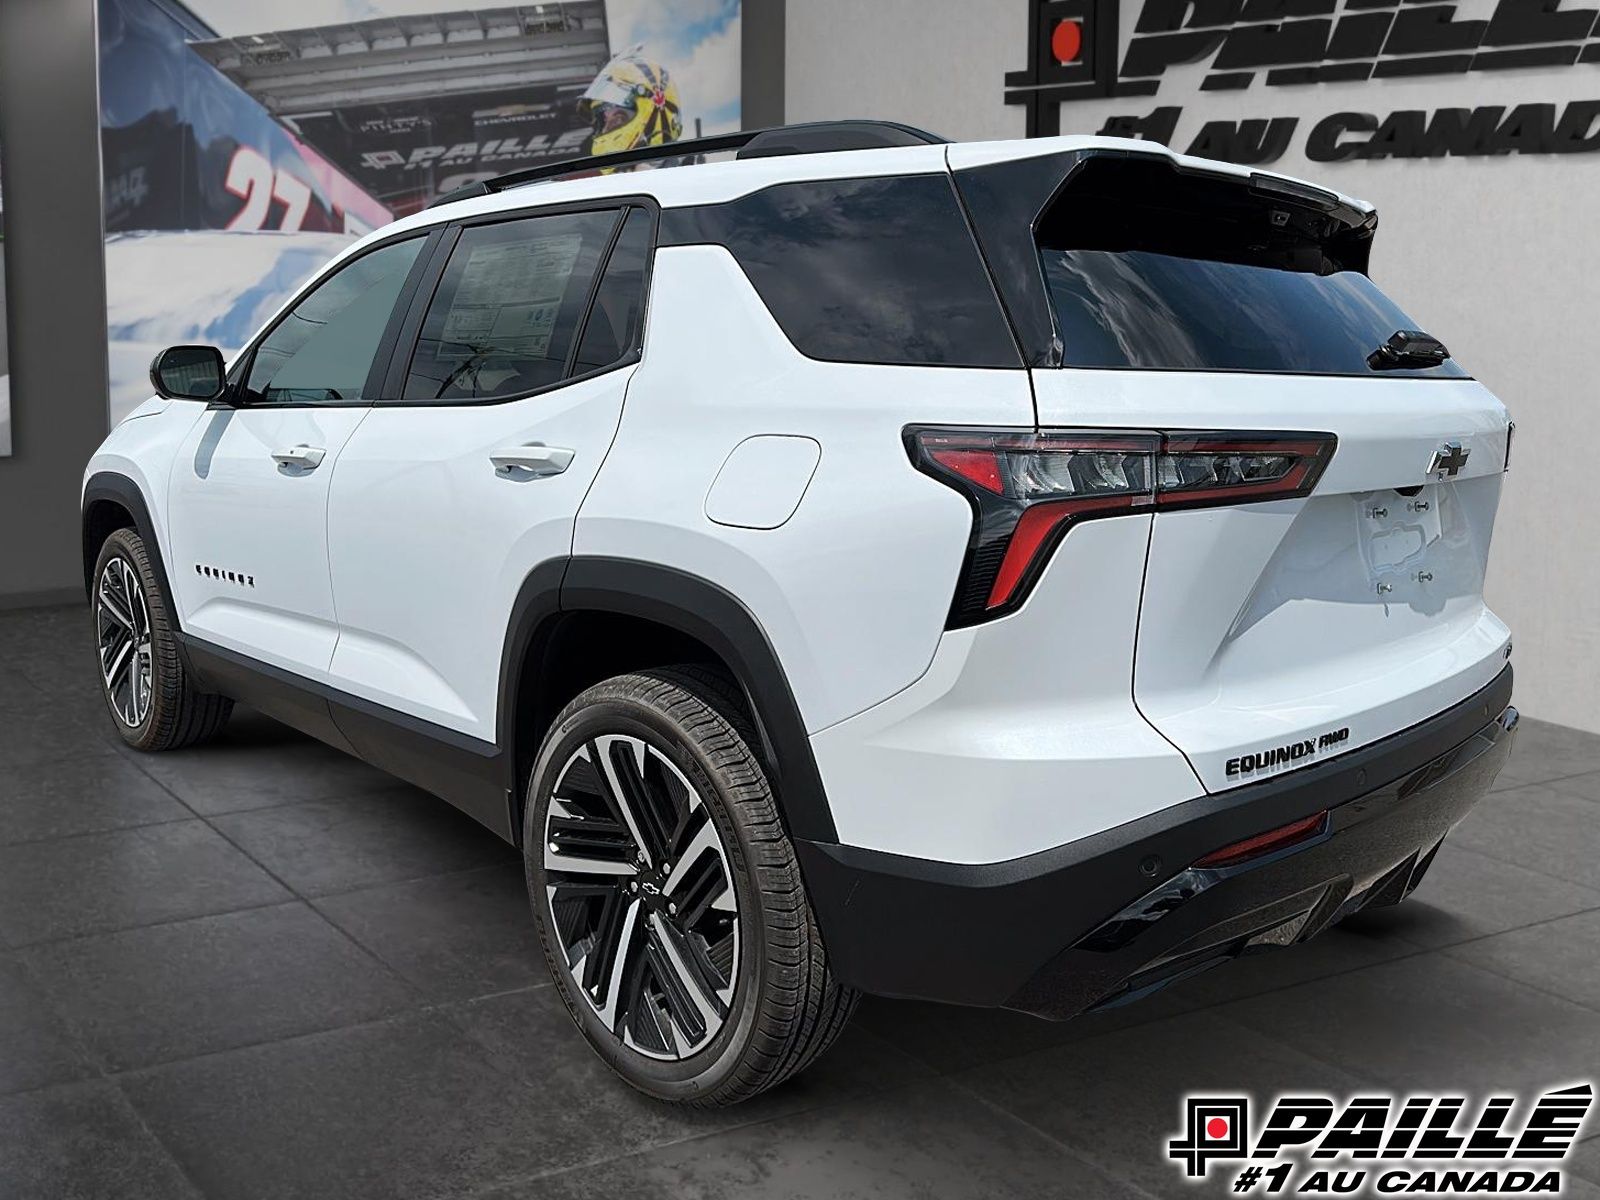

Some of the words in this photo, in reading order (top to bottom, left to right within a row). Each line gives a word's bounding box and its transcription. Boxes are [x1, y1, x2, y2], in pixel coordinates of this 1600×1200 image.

[474, 112, 557, 126] CHEVROLET
[1184, 117, 1300, 164] AU
[438, 157, 472, 167] AU
[481, 146, 580, 163] CANADA
[224, 144, 312, 233] 27
[194, 564, 255, 588] EQUINOX
[1225, 737, 1317, 776] EQUINOX
